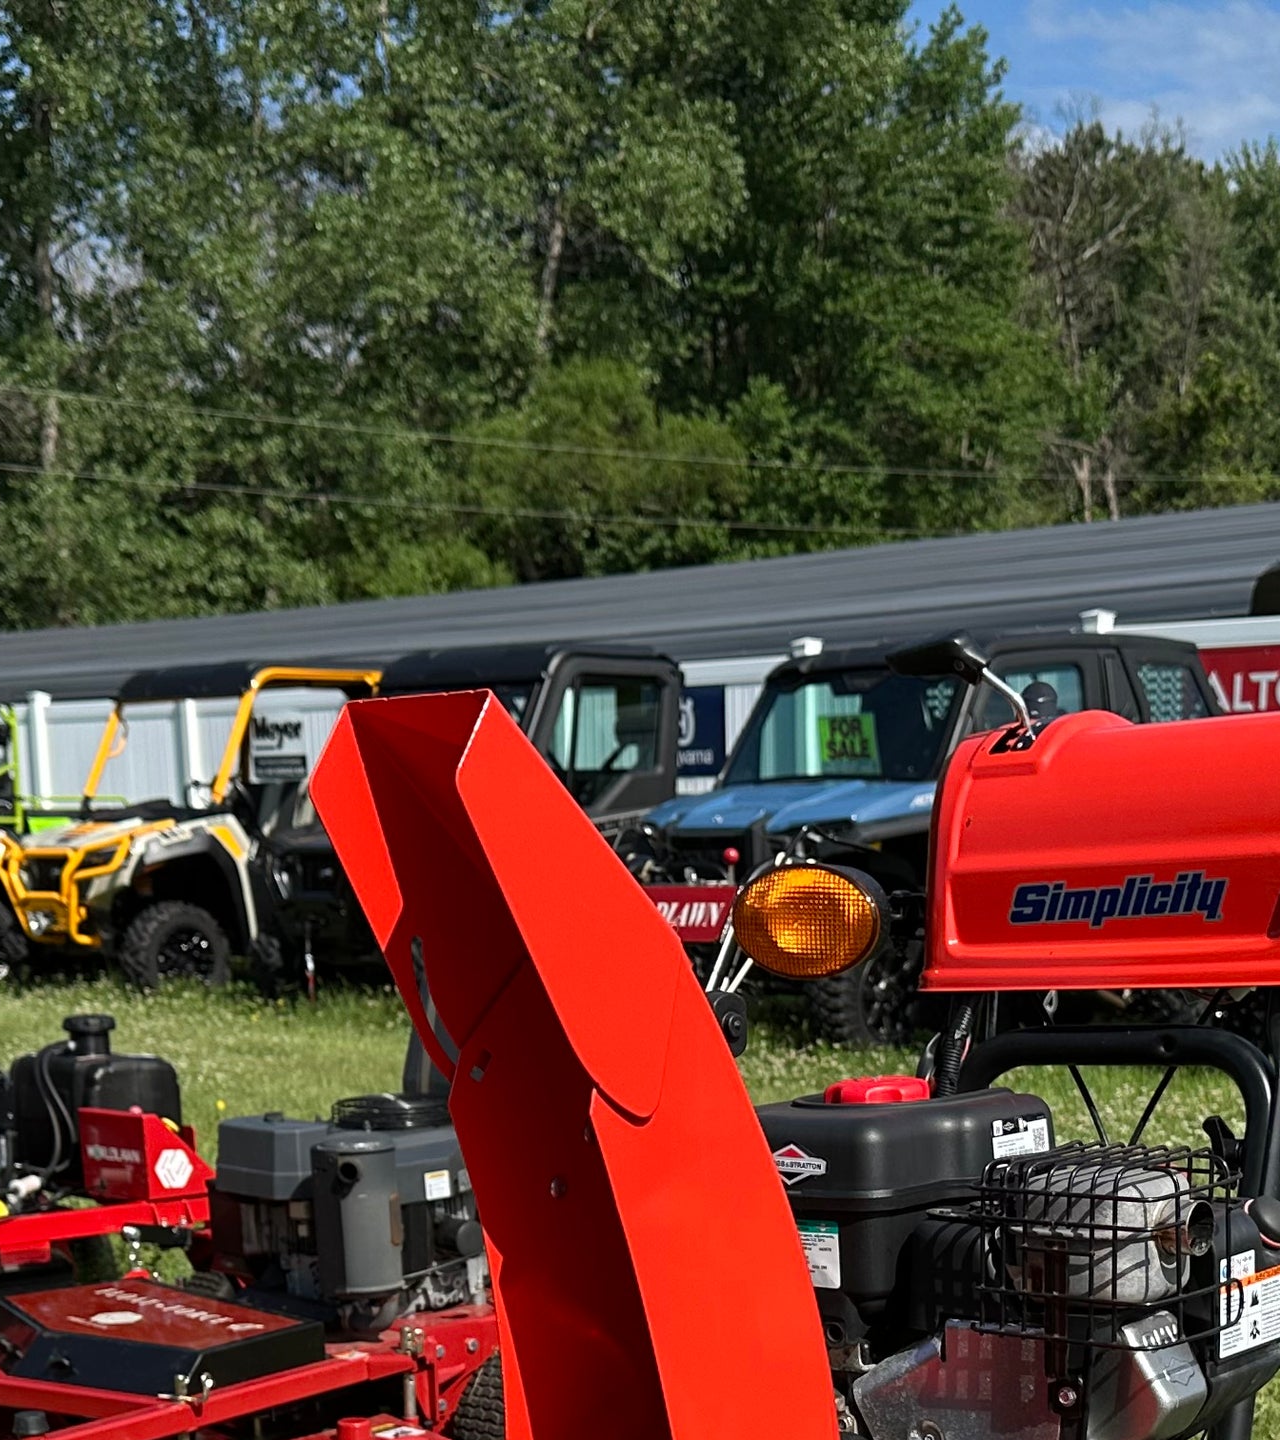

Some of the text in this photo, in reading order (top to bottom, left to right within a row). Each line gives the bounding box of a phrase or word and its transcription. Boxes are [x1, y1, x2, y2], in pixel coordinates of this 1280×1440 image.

[830, 717, 862, 738] FOR
[677, 748, 714, 767] varna
[827, 738, 871, 760] SALE
[1009, 869, 1229, 929] Simplicity
[657, 901, 726, 928] DLAWN
